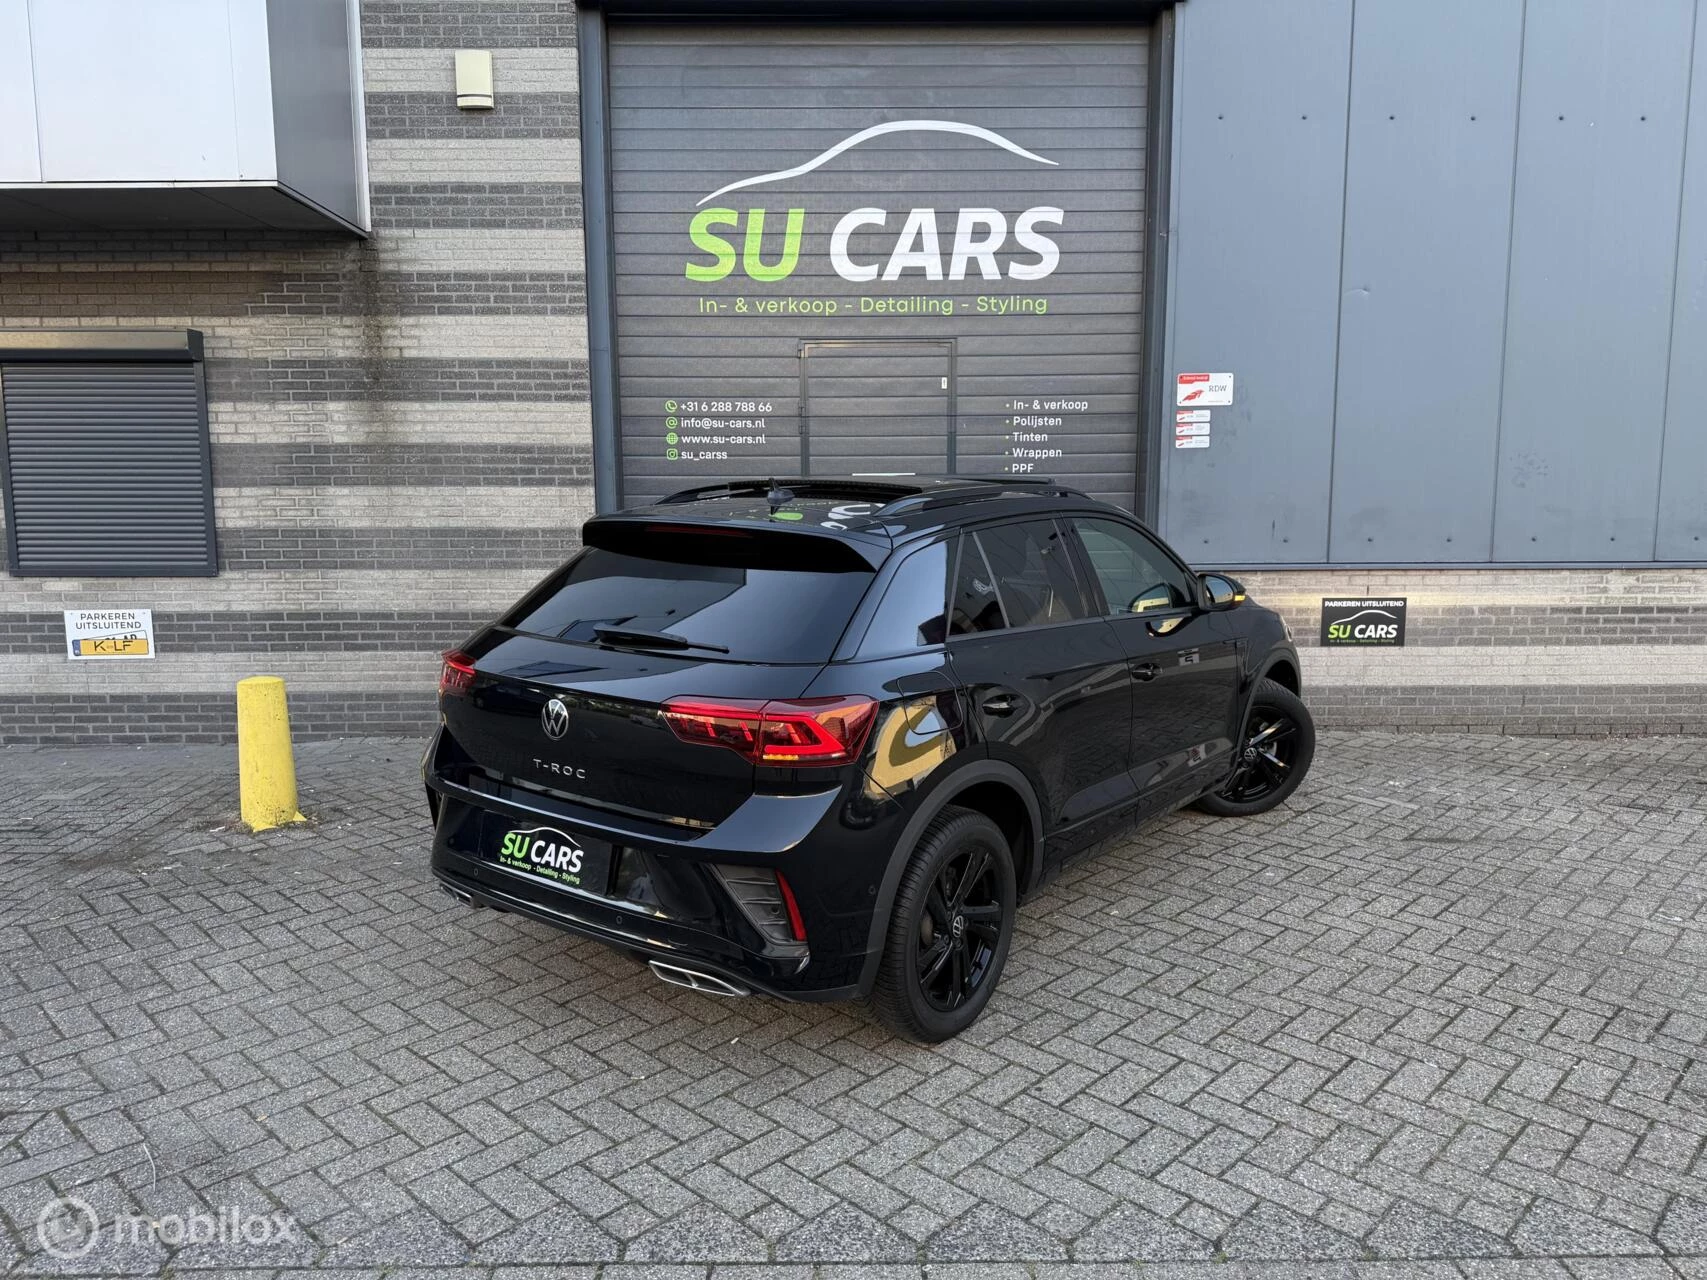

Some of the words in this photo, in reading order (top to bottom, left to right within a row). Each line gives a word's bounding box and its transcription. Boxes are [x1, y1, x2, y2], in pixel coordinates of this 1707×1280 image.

[686, 207, 805, 282] SU
[830, 206, 1064, 282] CARS
[699, 297, 727, 313] In-
[735, 297, 748, 313] &
[755, 297, 837, 316] verkoop
[860, 296, 953, 315] Detailing
[976, 295, 1047, 315] Styling
[1208, 384, 1228, 392] RDW
[680, 402, 698, 412] +31
[701, 402, 708, 412] 6
[711, 402, 732, 412] 288
[735, 402, 756, 412] 788
[758, 402, 773, 412] 66
[1013, 400, 1029, 410] In-
[1032, 399, 1041, 410] &
[1043, 399, 1089, 412] verkoop
[680, 417, 766, 430] info@su-cars.nl
[1013, 416, 1062, 428] Polijsten
[681, 434, 766, 444] www.su-cars.nl
[1012, 432, 1048, 442] Tinten
[681, 451, 728, 461] su_carss
[1012, 447, 1062, 459] Wrappen
[1012, 463, 1034, 473] PPF
[80, 612, 135, 621] PARKEREN
[75, 621, 142, 630] UITSLUITEND
[1328, 624, 1352, 639] SU
[1354, 624, 1399, 639] CARS
[533, 758, 586, 779] T-ROC
[501, 832, 530, 859] SU
[531, 840, 584, 873] CARS
[512, 860, 531, 870] verkoop
[536, 865, 558, 878] Detailing
[562, 873, 580, 884] Styling
